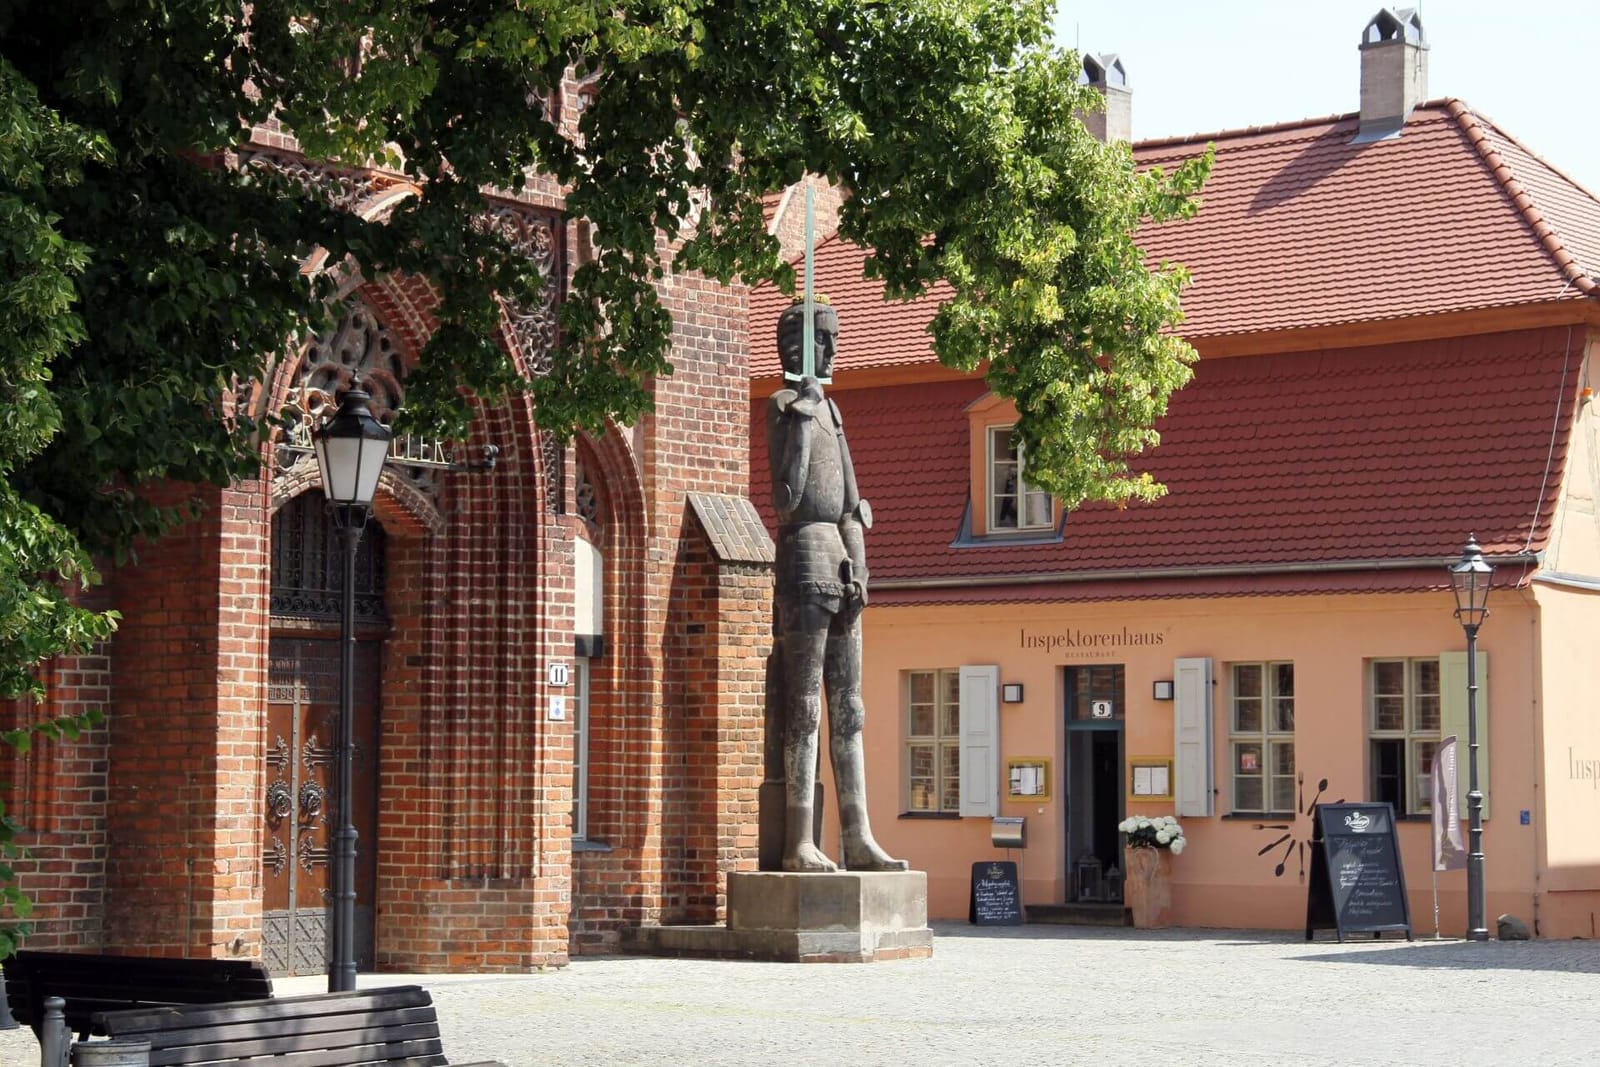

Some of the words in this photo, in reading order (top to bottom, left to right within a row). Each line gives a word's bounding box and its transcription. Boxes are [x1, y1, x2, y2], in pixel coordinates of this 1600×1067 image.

[1020, 626, 1164, 653] Inspektorenhaus
[554, 667, 564, 683] 11
[1098, 703, 1106, 716] 9
